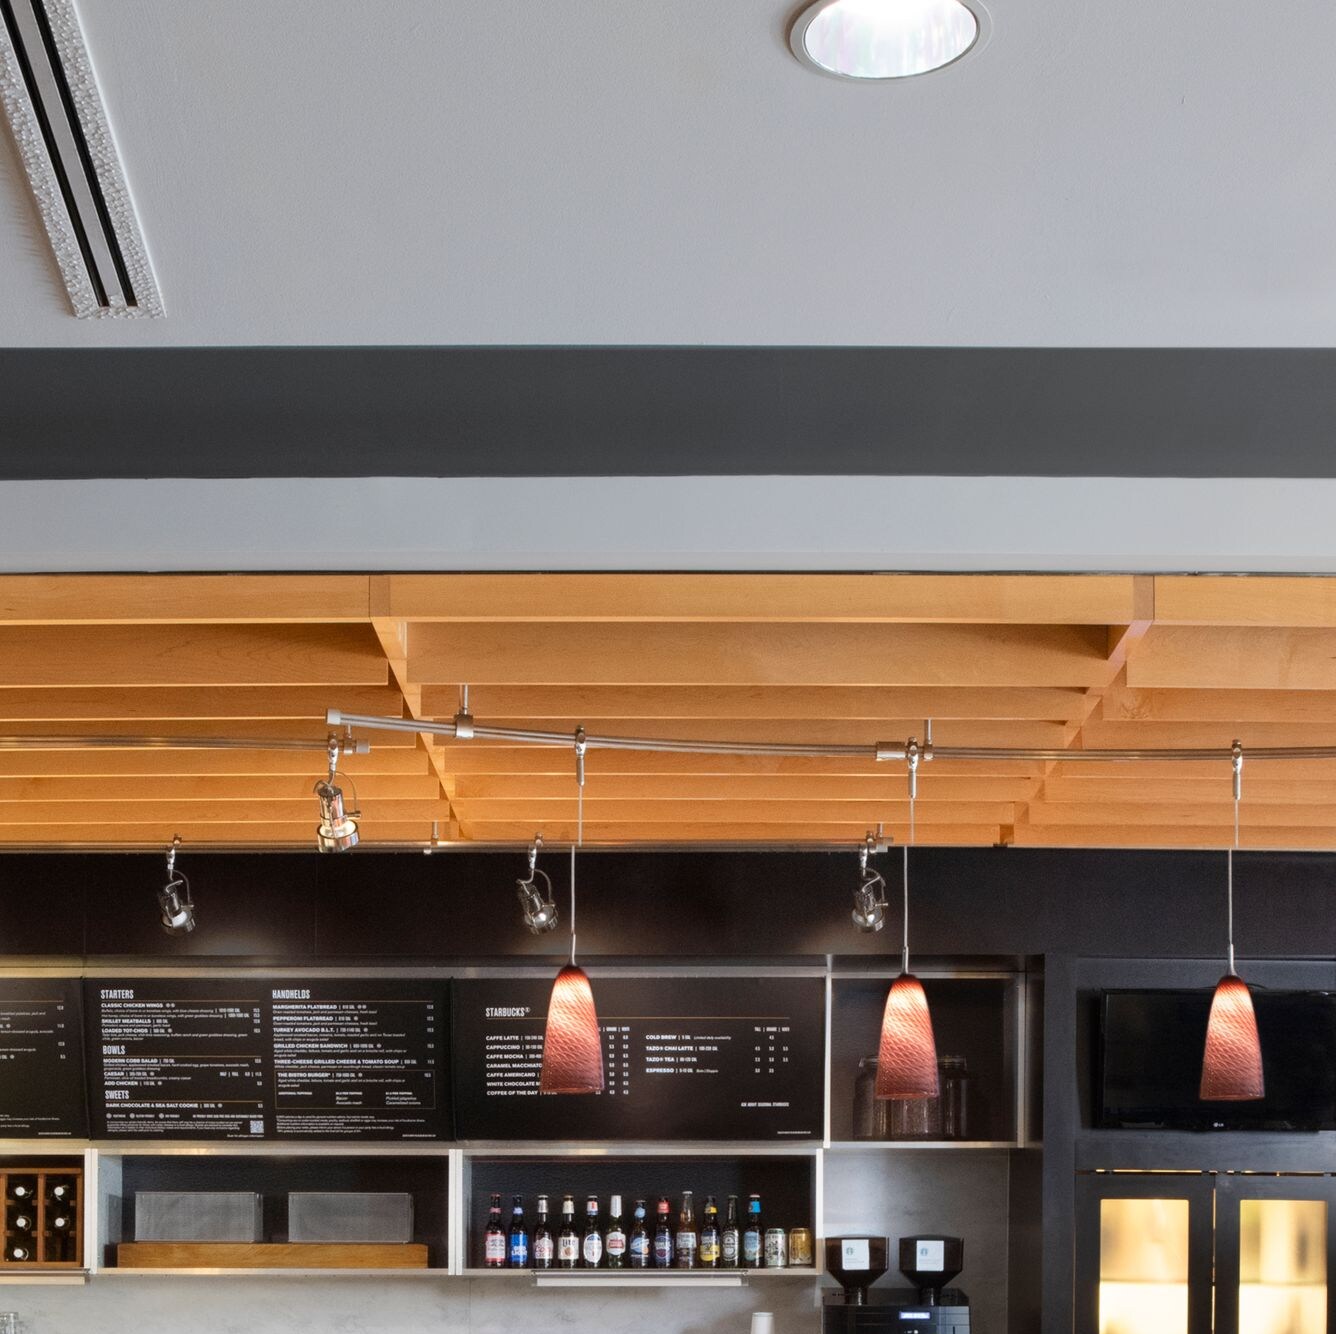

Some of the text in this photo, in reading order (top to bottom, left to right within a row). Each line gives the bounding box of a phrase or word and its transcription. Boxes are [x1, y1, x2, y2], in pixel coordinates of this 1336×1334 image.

[100, 989, 134, 999] STARTERS
[272, 989, 310, 999] HANDHELDS
[103, 1045, 126, 1055] BOWLS
[105, 1089, 130, 1100] SWEETS
